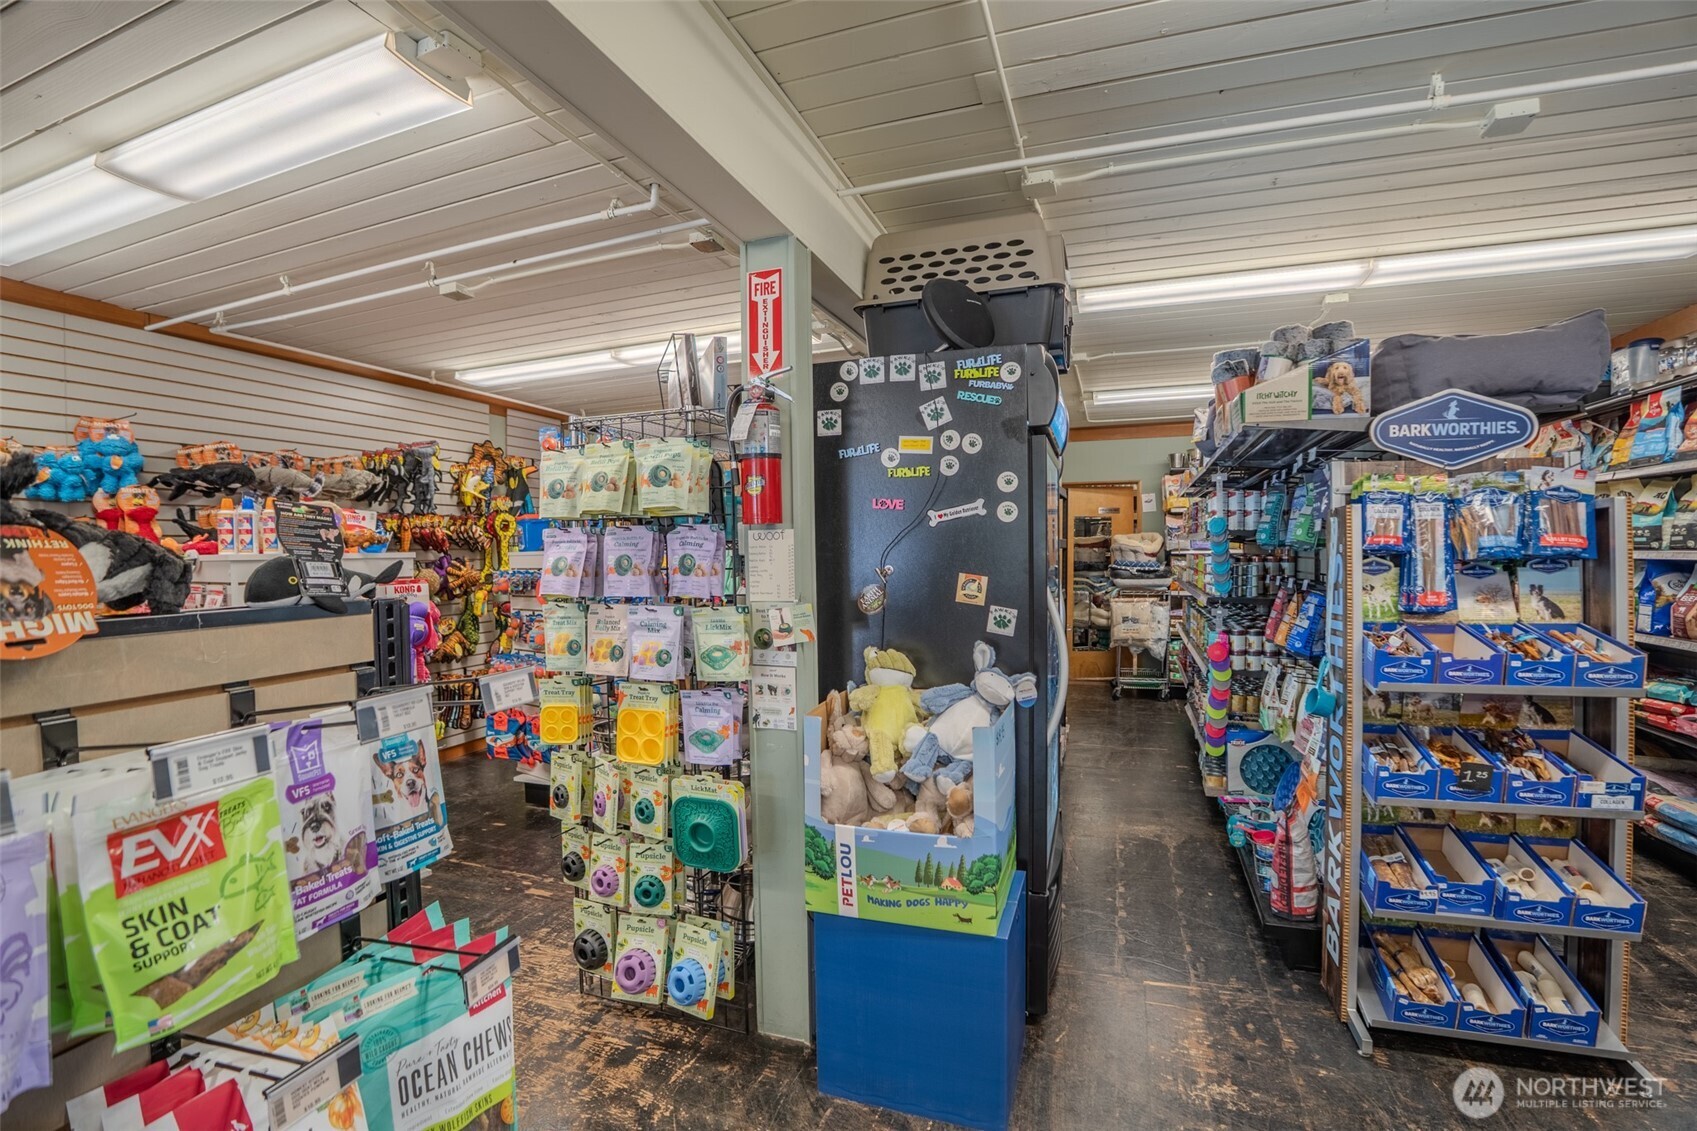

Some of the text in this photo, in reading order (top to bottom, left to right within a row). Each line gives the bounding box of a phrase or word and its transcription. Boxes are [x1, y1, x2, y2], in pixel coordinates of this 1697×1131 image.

[754, 281, 776, 296] FIRE
[1274, 390, 1298, 398] WITCHY
[872, 498, 904, 510] LOVE
[962, 506, 979, 514] Retriever
[5, 538, 69, 549] RETHINK
[394, 585, 416, 594] KONG
[860, 586, 878, 604] EARTH
[862, 589, 884, 610] ANIMAL
[382, 750, 397, 760] VFS
[1462, 770, 1489, 783] 1.25
[292, 785, 310, 800] VFS
[690, 784, 718, 794] LickMat
[220, 801, 246, 819] TREATS
[376, 822, 414, 845] oft-Baked
[415, 817, 435, 832] Treats
[394, 832, 417, 847] DIGESTIVE
[418, 825, 436, 840] SUPPORT
[636, 852, 666, 860] Pupsicle
[292, 864, 353, 895] -Baked Treats
[840, 842, 854, 907] PETLOU
[1279, 838, 1288, 907] FREEZE DRIED
[308, 881, 342, 903] FORMULA
[866, 894, 968, 909] MAKING DOGS HAPPY
[122, 897, 189, 938] SKIN
[1516, 910, 1560, 918] BARKWORTHIES
[1584, 916, 1630, 924] BARKWORTHIES
[130, 938, 150, 960] &
[156, 904, 219, 947] COAT
[626, 924, 654, 934] Pupsicle
[682, 934, 708, 946] Pupsicle
[132, 940, 196, 972] SUPPORT
[310, 989, 331, 1002] LOOKING
[332, 984, 341, 992] FOR
[364, 996, 384, 1009] LOOKING
[384, 990, 393, 1000] FOR
[1469, 1020, 1511, 1028] BARKWORTHIES
[1542, 1022, 1586, 1032] BARKWORTHIES
[396, 1036, 460, 1077] Pure Tasty
[398, 1050, 459, 1107] OCEAN
[462, 1016, 512, 1071] CHEWS
[434, 1084, 461, 1101] NATURAL
[462, 1067, 485, 1086] RAWHIDE
[438, 1108, 474, 1131] WOLFFISH
[474, 1094, 493, 1113] SKINS
